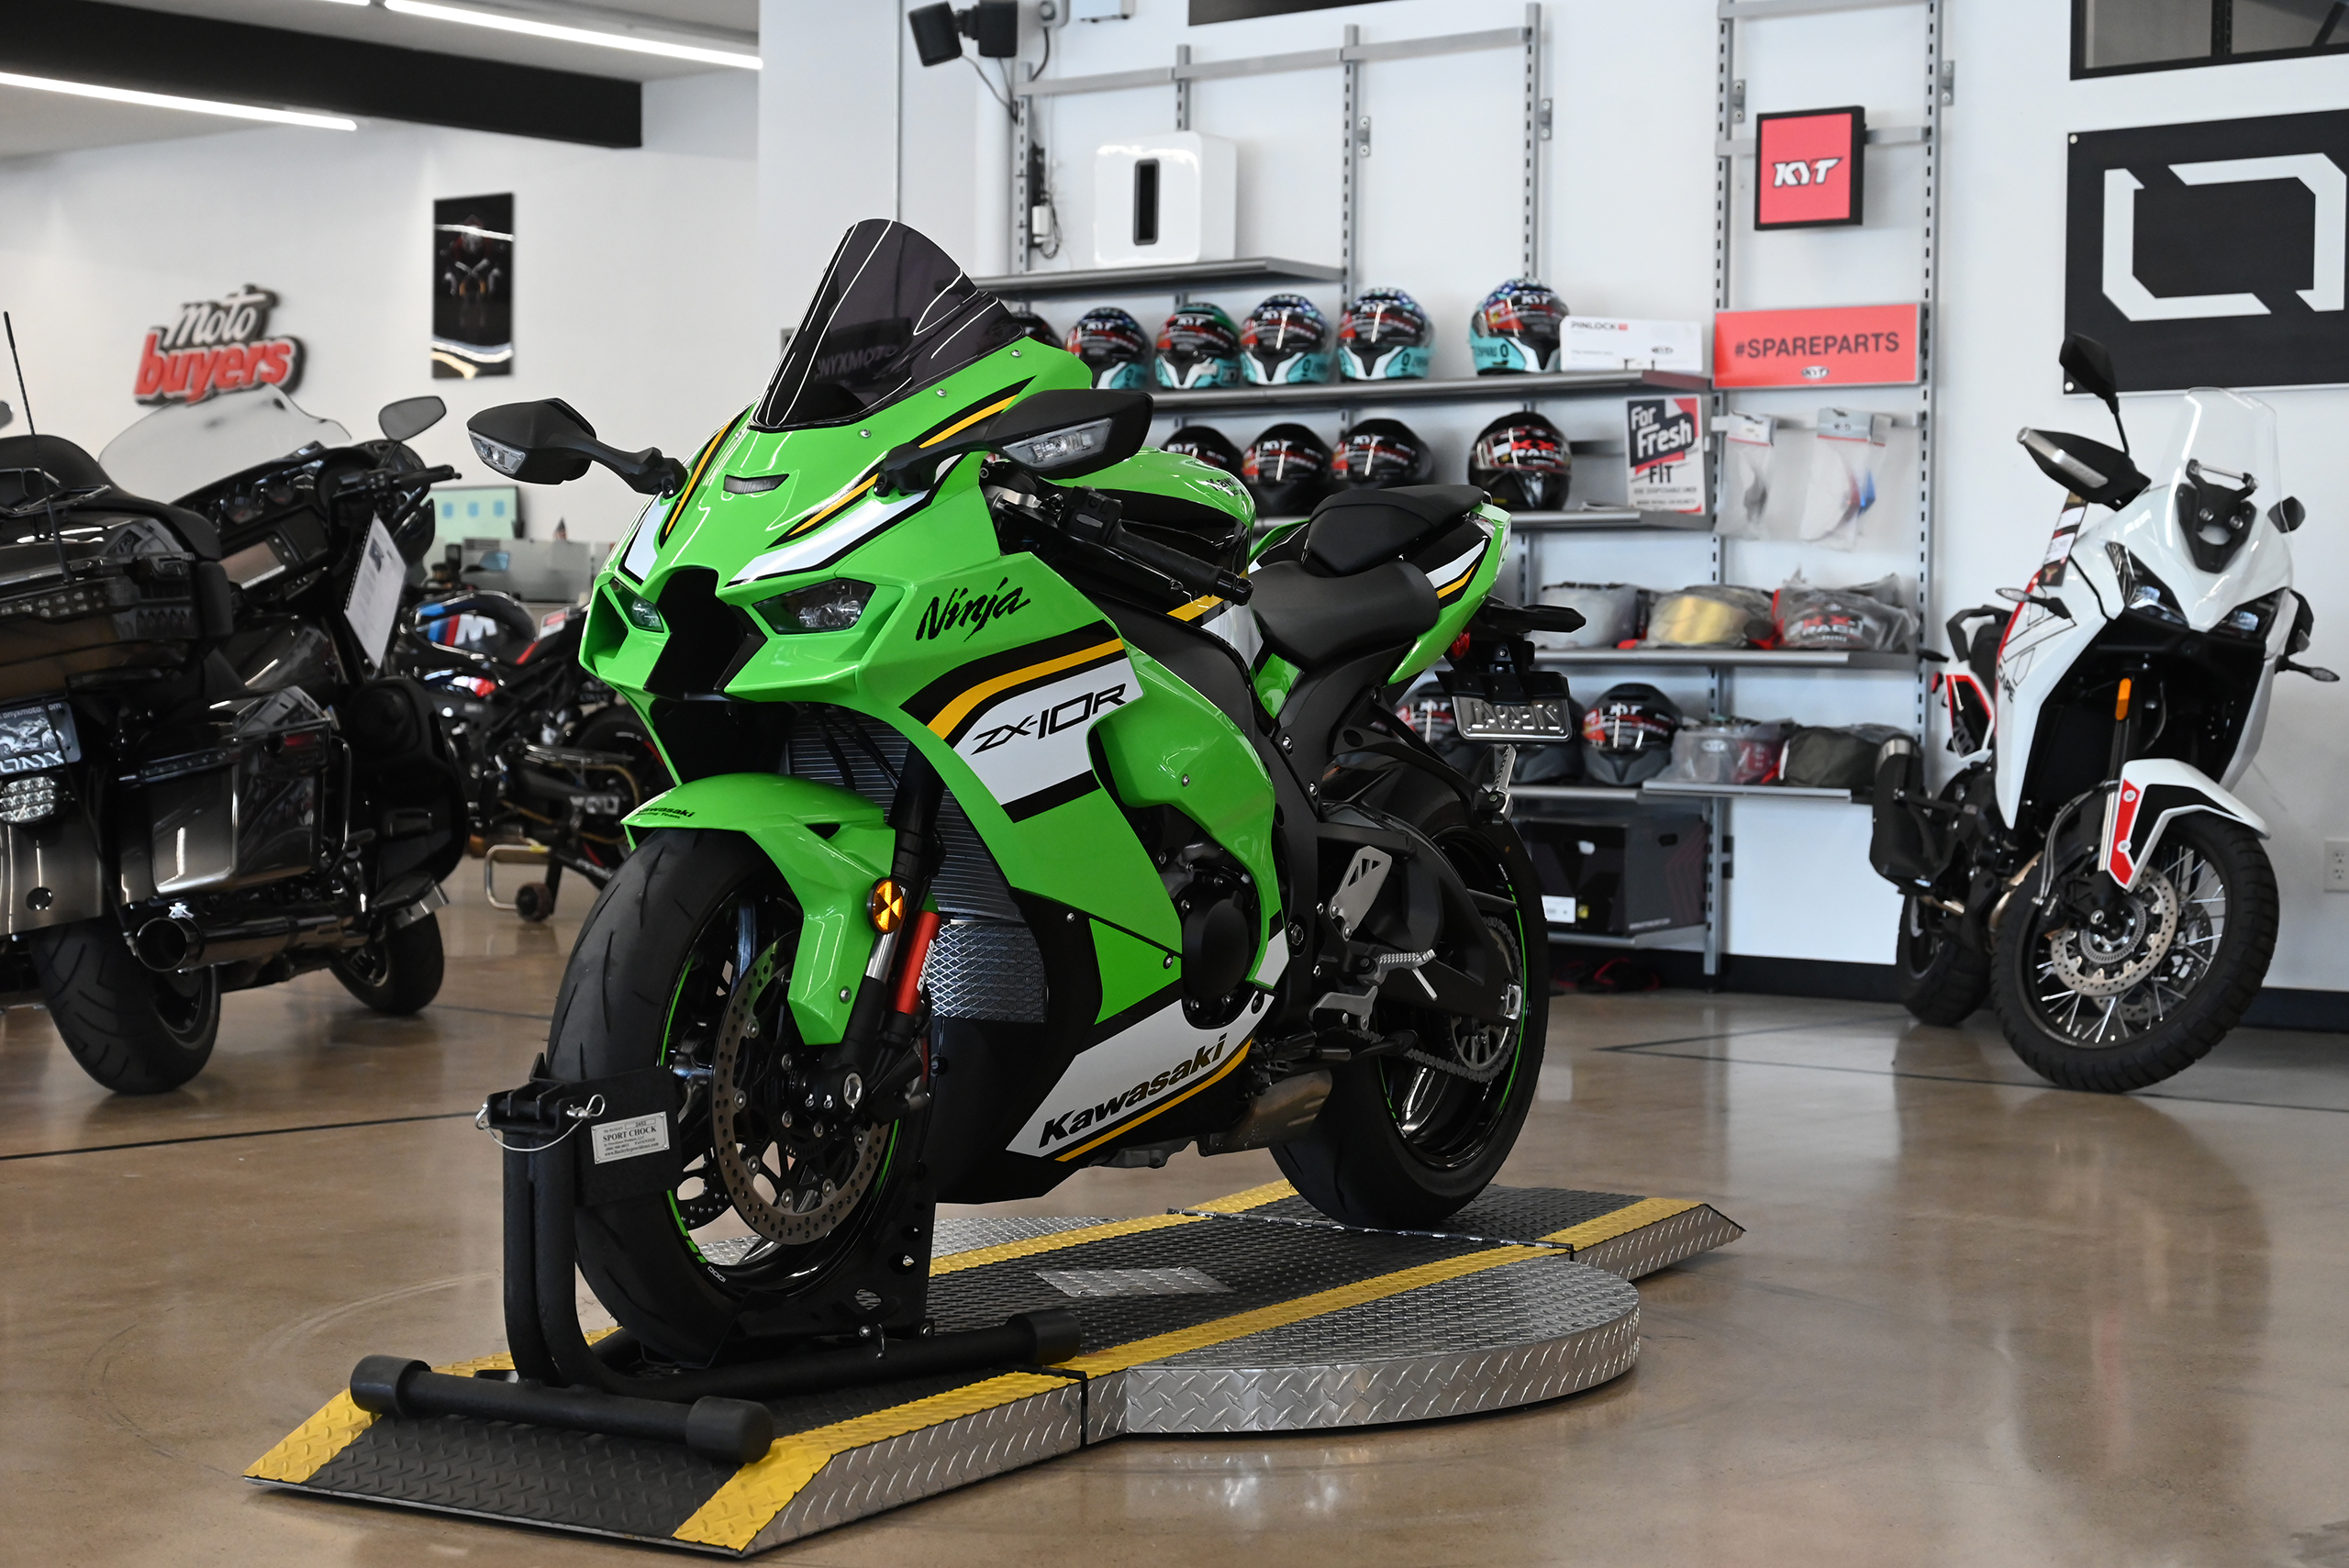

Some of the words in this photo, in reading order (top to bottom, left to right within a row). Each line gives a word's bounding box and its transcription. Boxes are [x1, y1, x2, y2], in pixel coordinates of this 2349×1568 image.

[1773, 157, 1843, 187] KYT
[1521, 295, 1552, 305] KYT
[1085, 321, 1116, 330] KYT
[1177, 316, 1207, 326] KYT
[1734, 331, 1900, 359] #SPAREPARTS
[134, 331, 292, 403] buyers
[1631, 406, 1656, 430] For
[1637, 418, 1693, 459] Fresh
[1650, 462, 1674, 484] FIT
[916, 577, 1031, 642] Ninja
[970, 683, 1127, 756] ZX-10R
[0, 750, 64, 773] ONYX
[640, 807, 696, 817] awasaki
[1038, 1032, 1228, 1149] Kawasaki
[602, 1131, 627, 1141] SPORT
[629, 1125, 656, 1137] CHOCK
